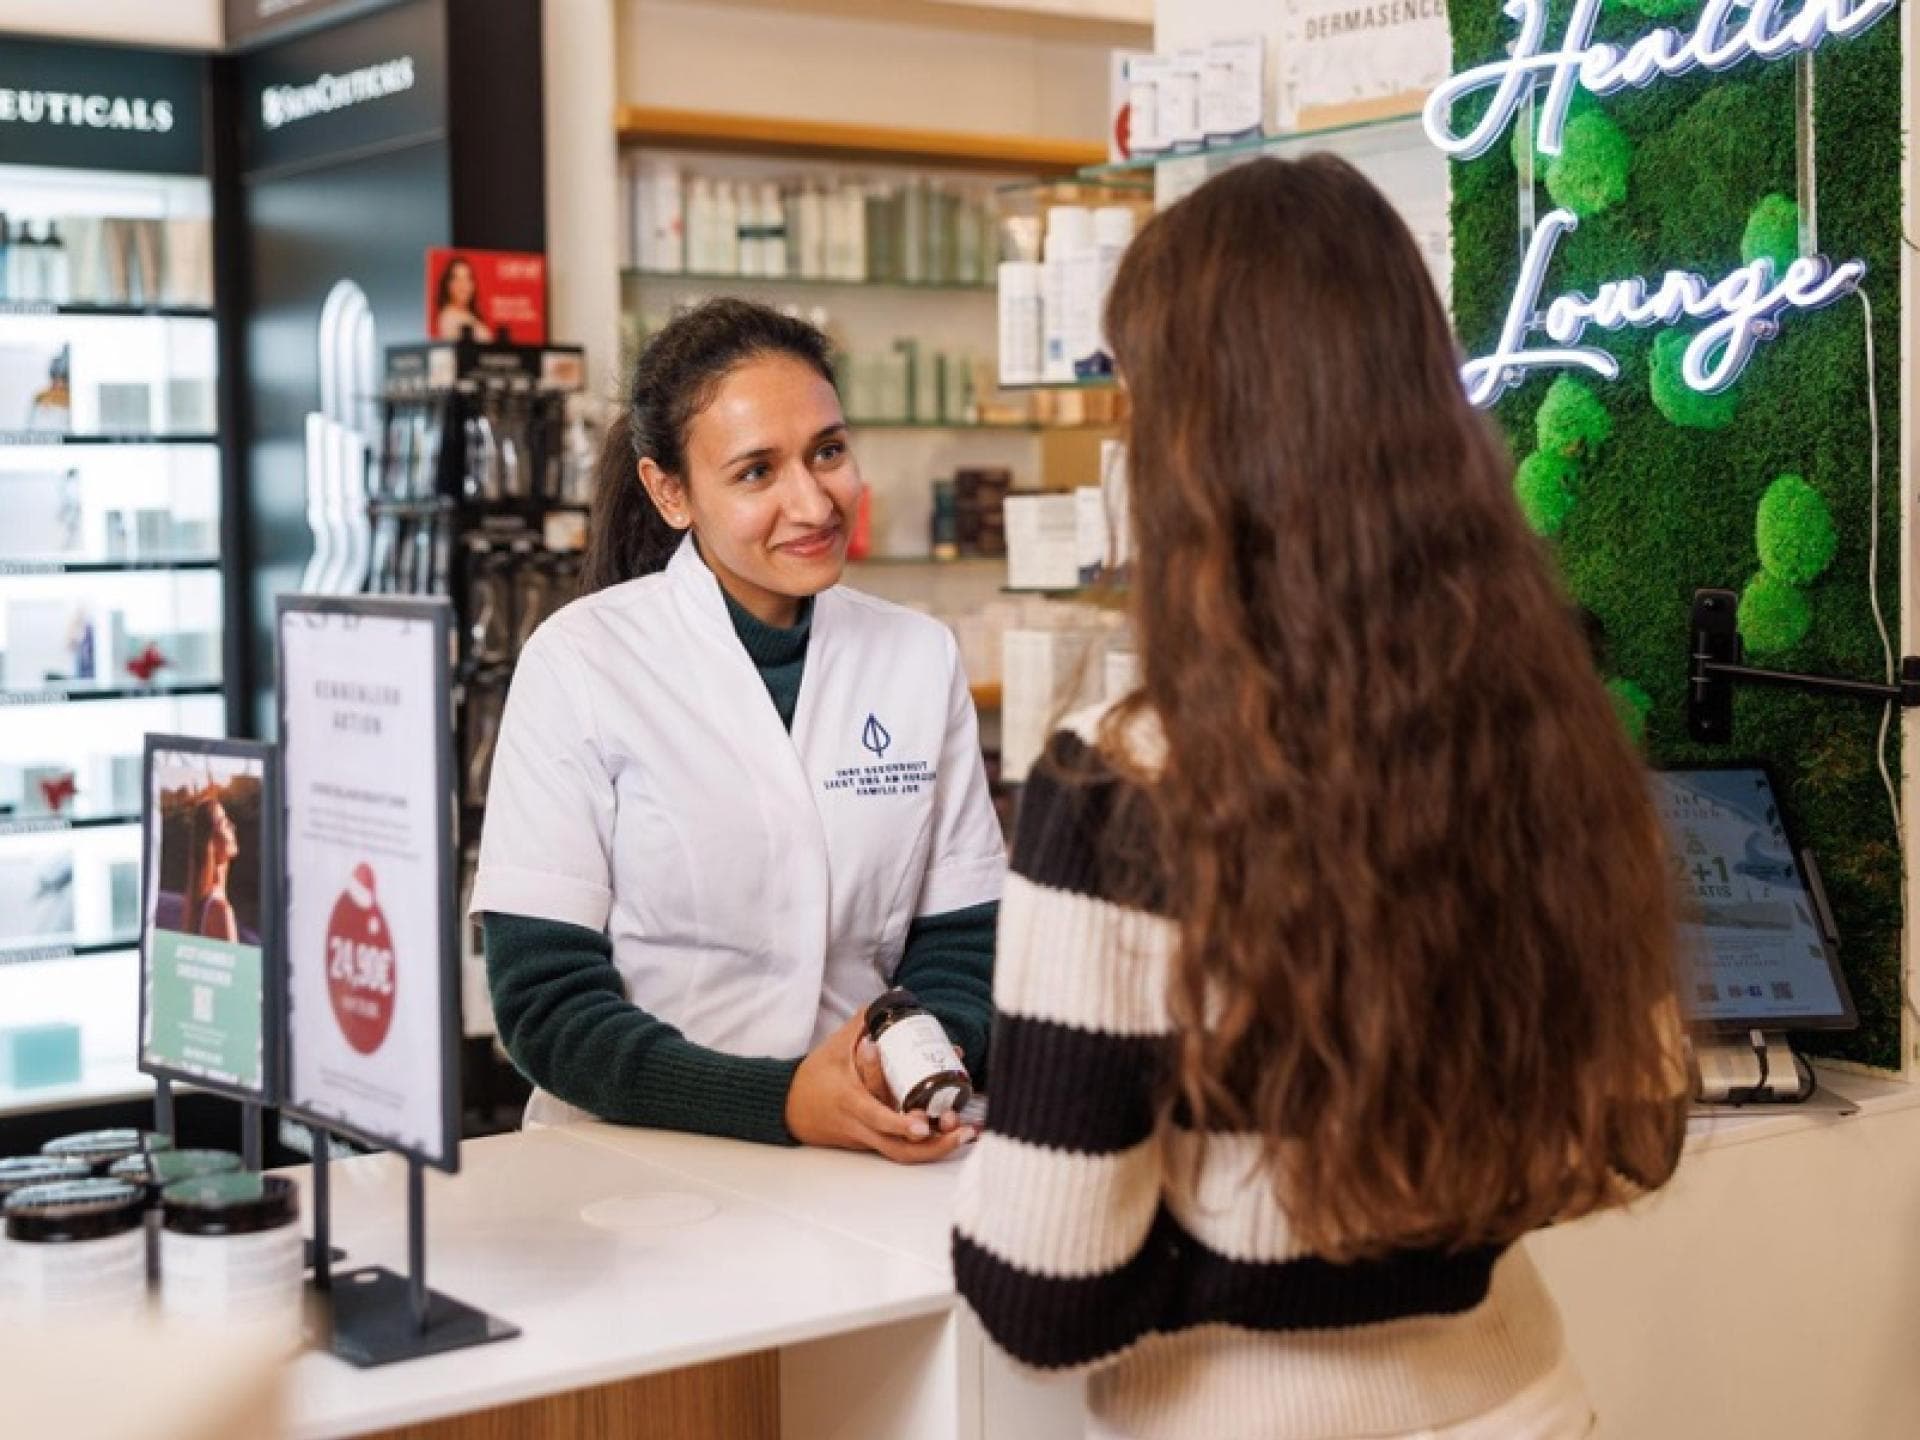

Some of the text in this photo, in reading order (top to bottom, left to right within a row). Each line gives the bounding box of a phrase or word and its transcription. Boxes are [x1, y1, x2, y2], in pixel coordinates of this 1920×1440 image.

[1305, 0, 1444, 41] DERMASENCE
[0, 88, 174, 132] EUTICALS
[1460, 208, 1866, 406] Lounge
